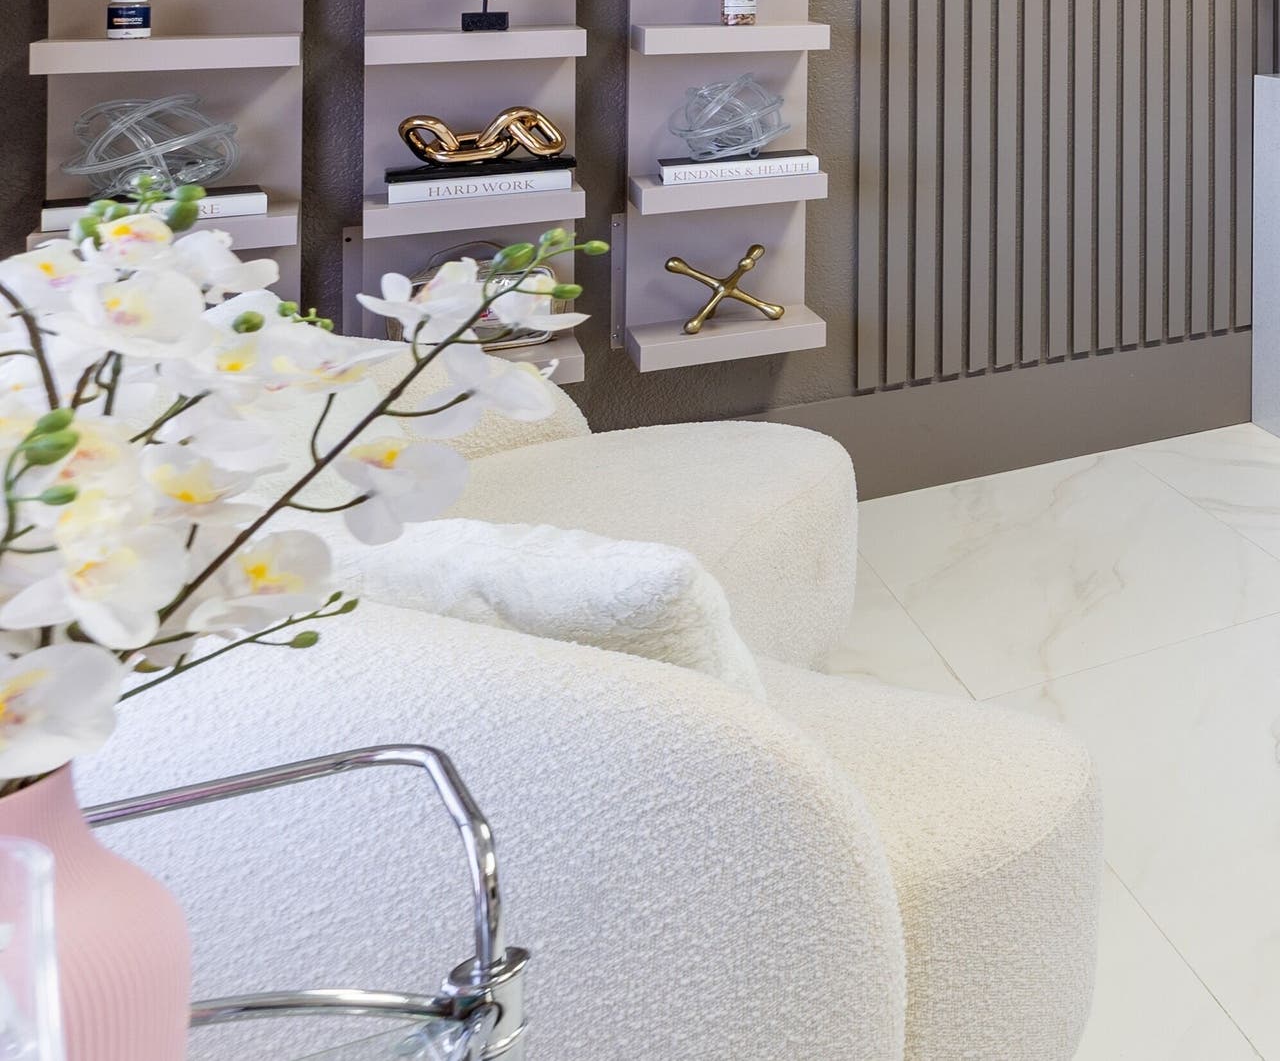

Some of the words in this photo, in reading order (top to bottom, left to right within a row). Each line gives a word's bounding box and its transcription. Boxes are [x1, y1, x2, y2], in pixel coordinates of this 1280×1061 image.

[673, 168, 740, 181] KINDNESS
[744, 166, 754, 177] &
[758, 161, 811, 175] HEALTH
[427, 184, 478, 198] HARD
[482, 179, 535, 193] WORK
